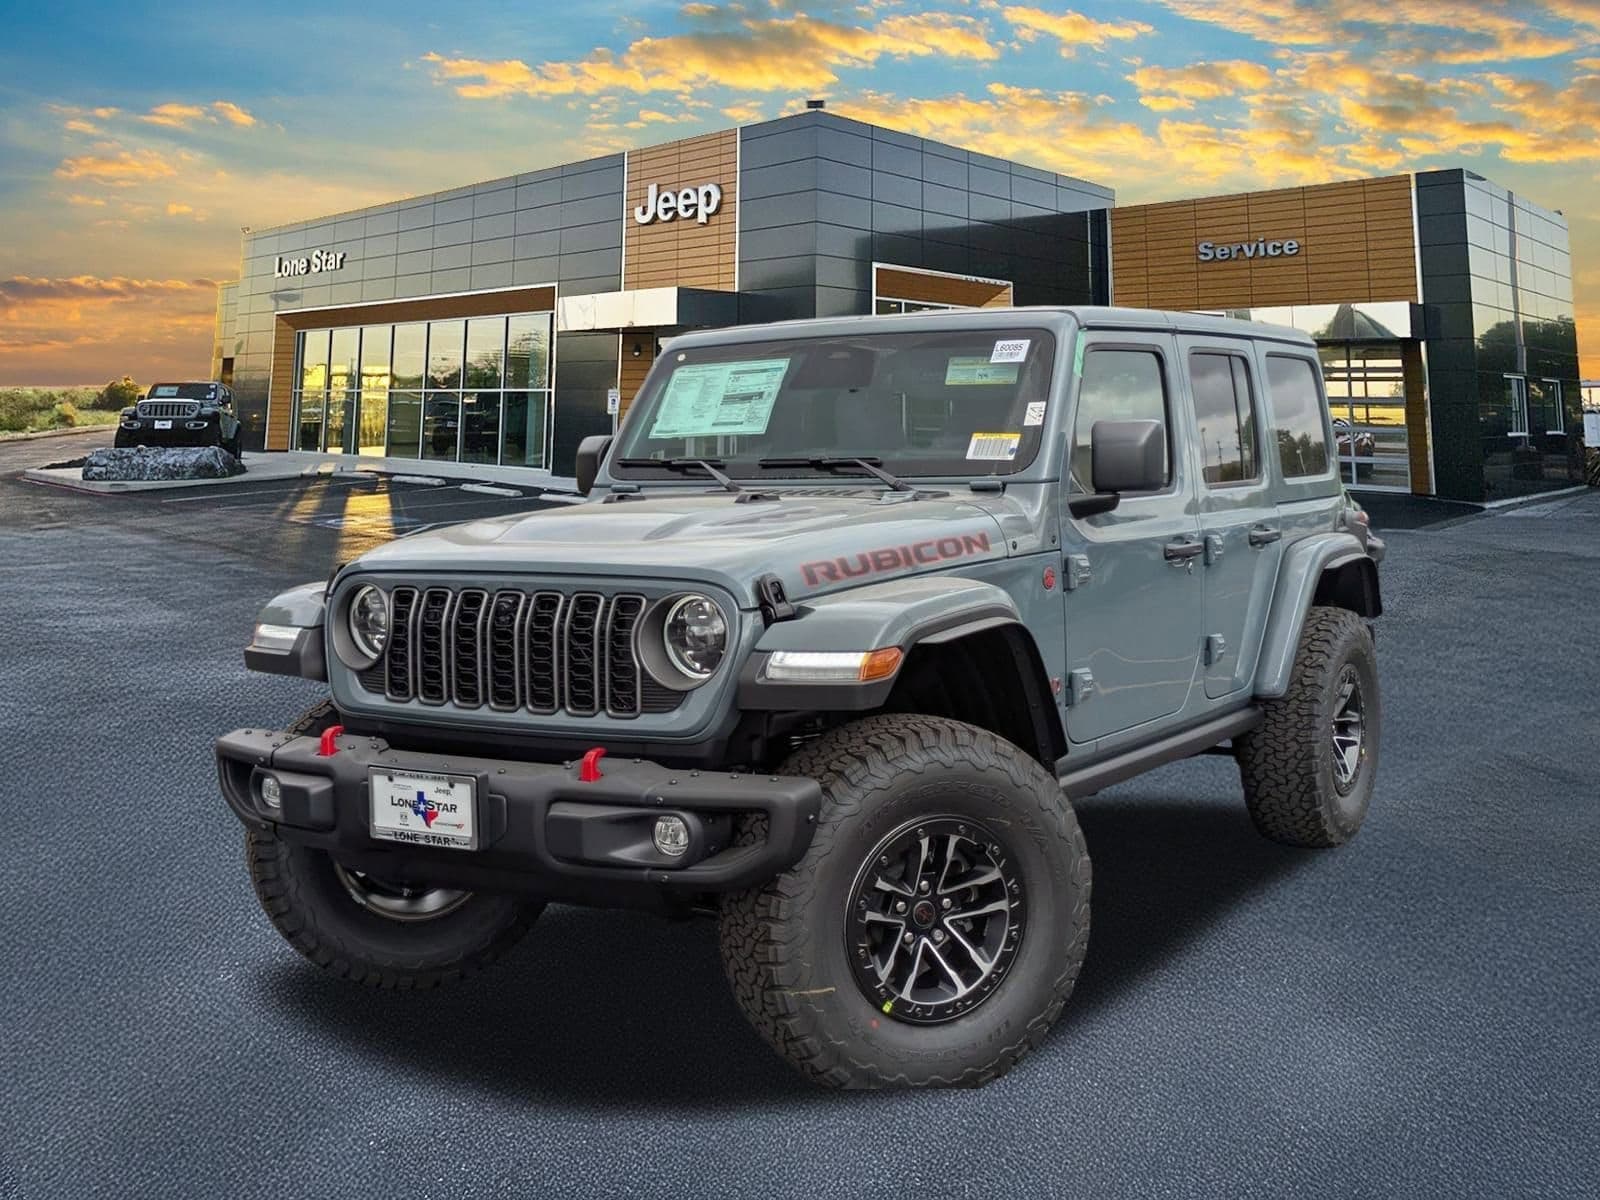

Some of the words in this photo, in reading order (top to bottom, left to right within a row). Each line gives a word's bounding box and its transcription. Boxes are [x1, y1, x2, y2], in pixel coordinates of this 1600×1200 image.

[634, 183, 722, 225] Jeep
[1198, 236, 1300, 261] Service
[275, 256, 310, 278] Lone
[311, 249, 346, 273] Star
[801, 531, 992, 587] RUBICON
[391, 795, 419, 809] LONE
[427, 799, 457, 813] STAR
[394, 831, 421, 842] LONE
[424, 834, 450, 846] STAR
